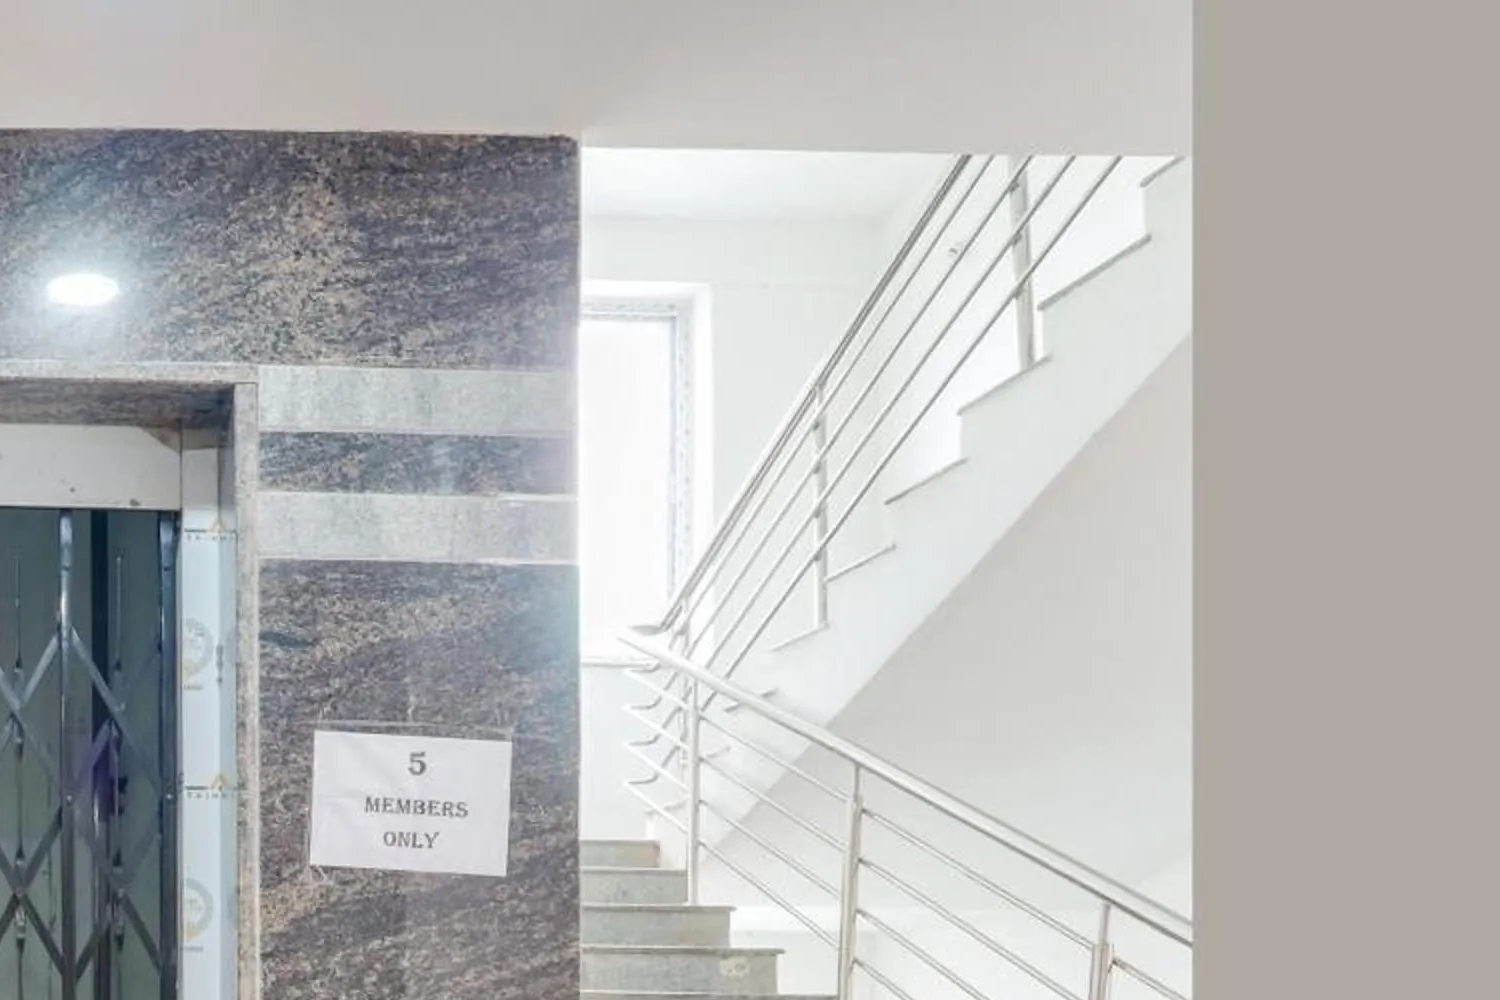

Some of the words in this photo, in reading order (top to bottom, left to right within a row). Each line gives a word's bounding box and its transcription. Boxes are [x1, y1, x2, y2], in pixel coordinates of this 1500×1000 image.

[408, 751, 427, 776] 5
[364, 796, 469, 818] MEMBERS
[383, 831, 440, 849] ONLY
